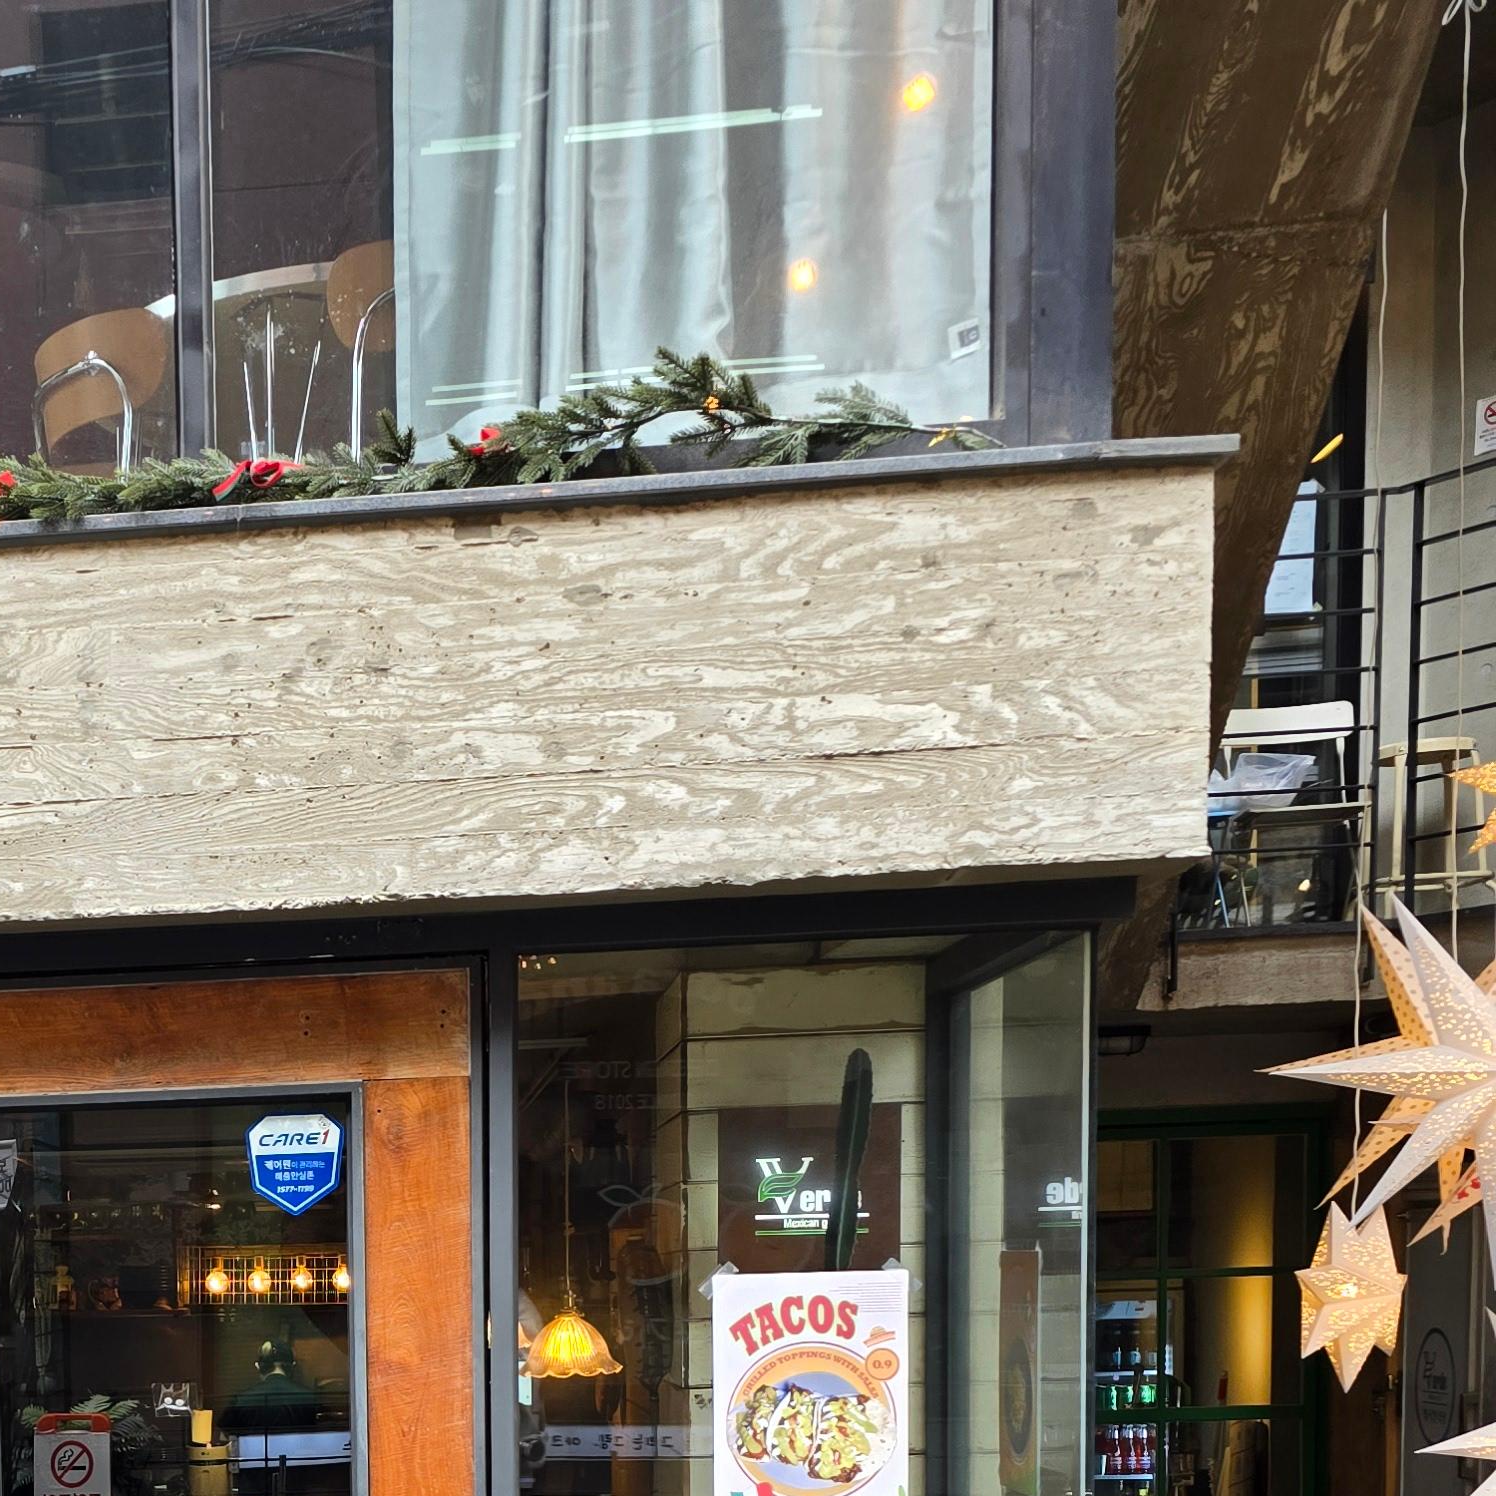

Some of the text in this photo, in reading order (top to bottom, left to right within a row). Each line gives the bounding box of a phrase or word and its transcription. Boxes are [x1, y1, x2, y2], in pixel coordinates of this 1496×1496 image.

[258, 1128, 330, 1147] CARE1
[756, 1157, 862, 1214] Ver
[729, 1295, 858, 1356] TACOS
[743, 1361, 777, 1396] GRILLED
[778, 1351, 832, 1365] TOPPINGS
[833, 1355, 859, 1374] WITH
[872, 1359, 892, 1369] 0.9
